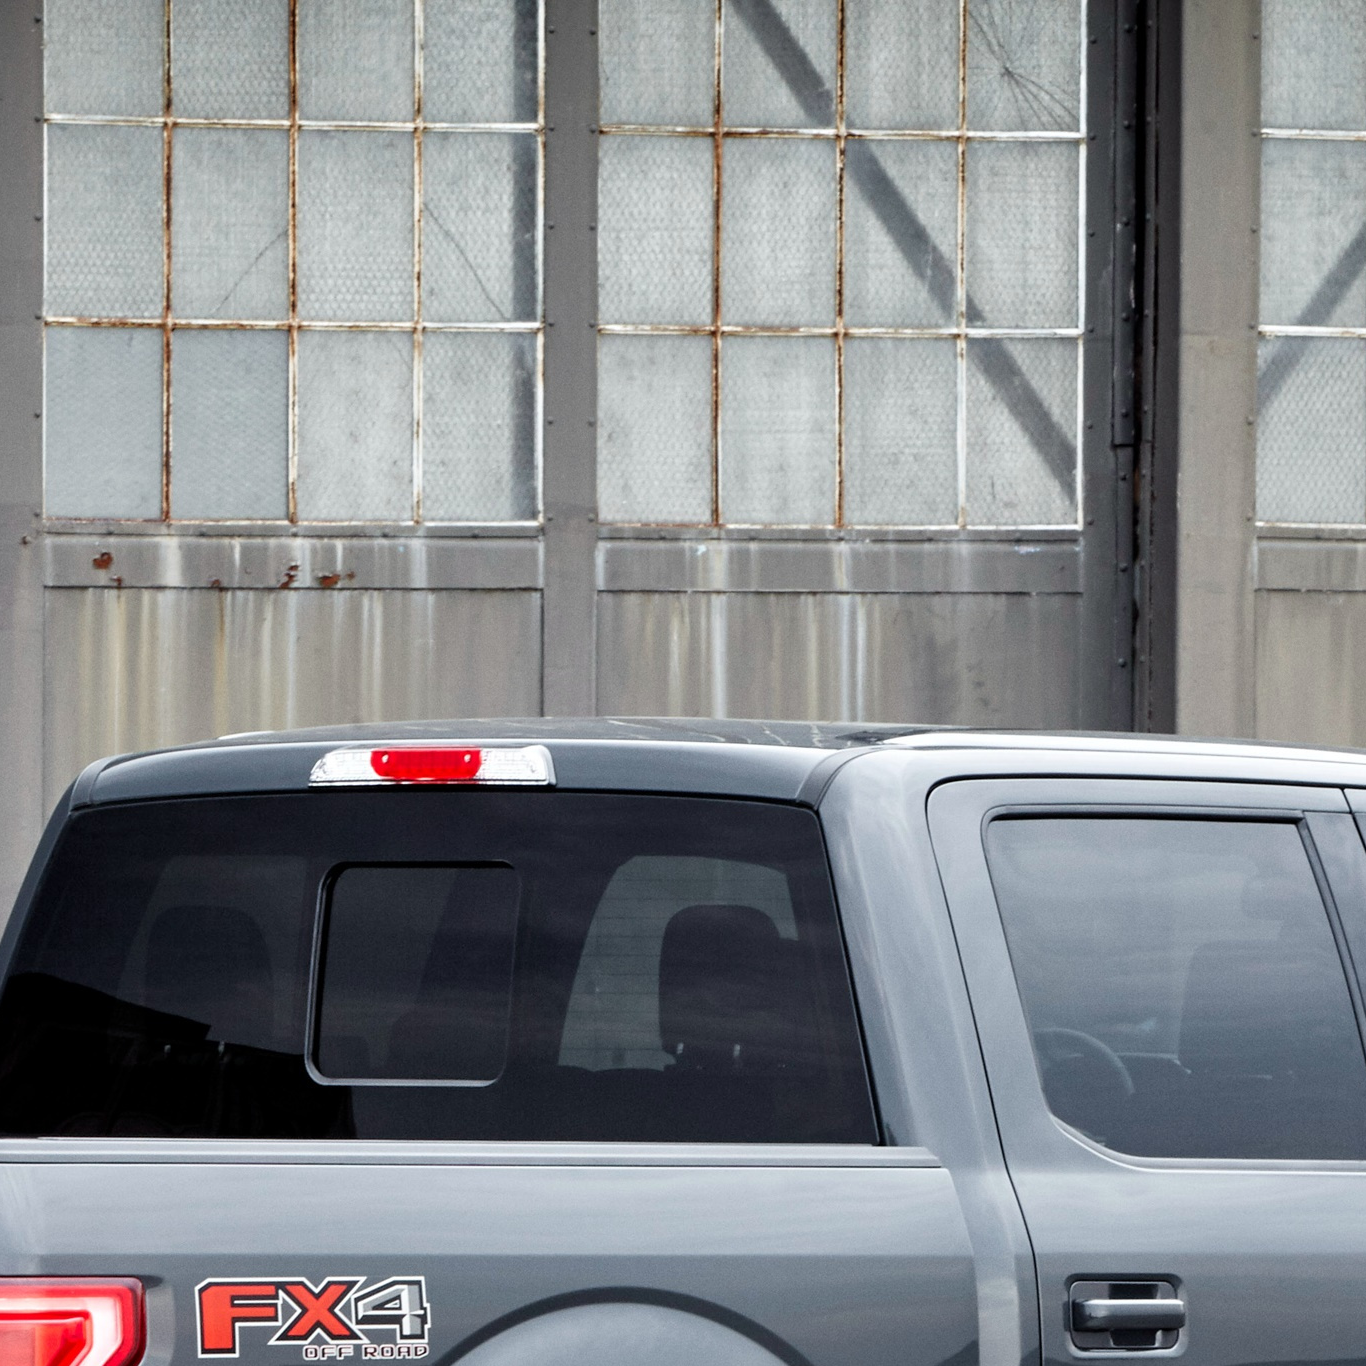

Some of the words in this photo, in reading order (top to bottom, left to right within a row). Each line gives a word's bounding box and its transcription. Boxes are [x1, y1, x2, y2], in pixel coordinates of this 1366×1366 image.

[195, 1276, 431, 1358] FX4
[302, 1344, 354, 1360] OFF
[362, 1343, 429, 1359] ROAD
